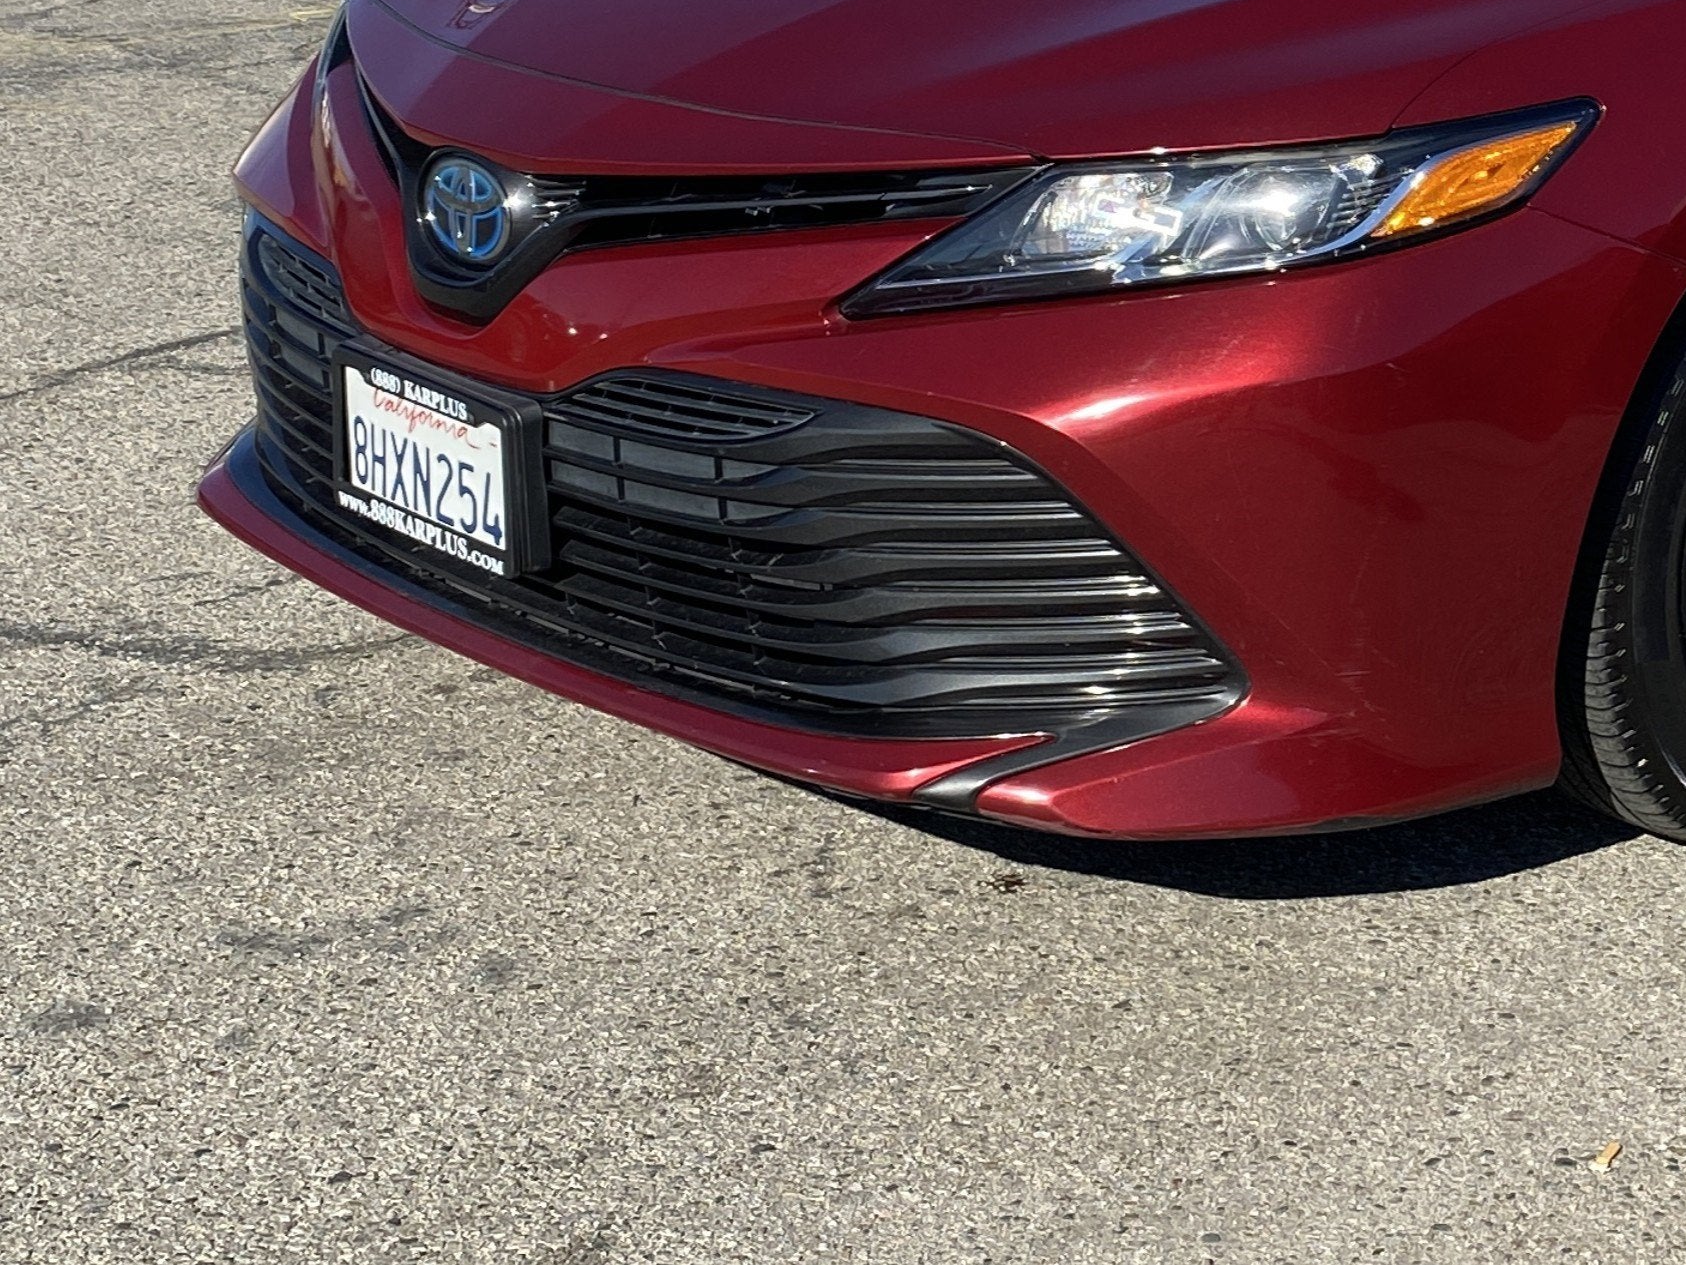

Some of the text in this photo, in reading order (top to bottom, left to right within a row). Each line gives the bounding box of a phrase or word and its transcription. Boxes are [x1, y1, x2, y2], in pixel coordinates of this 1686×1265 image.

[370, 367, 468, 421] (888) KARPLUS
[371, 388, 482, 450] California
[353, 415, 503, 546] 8HXN254
